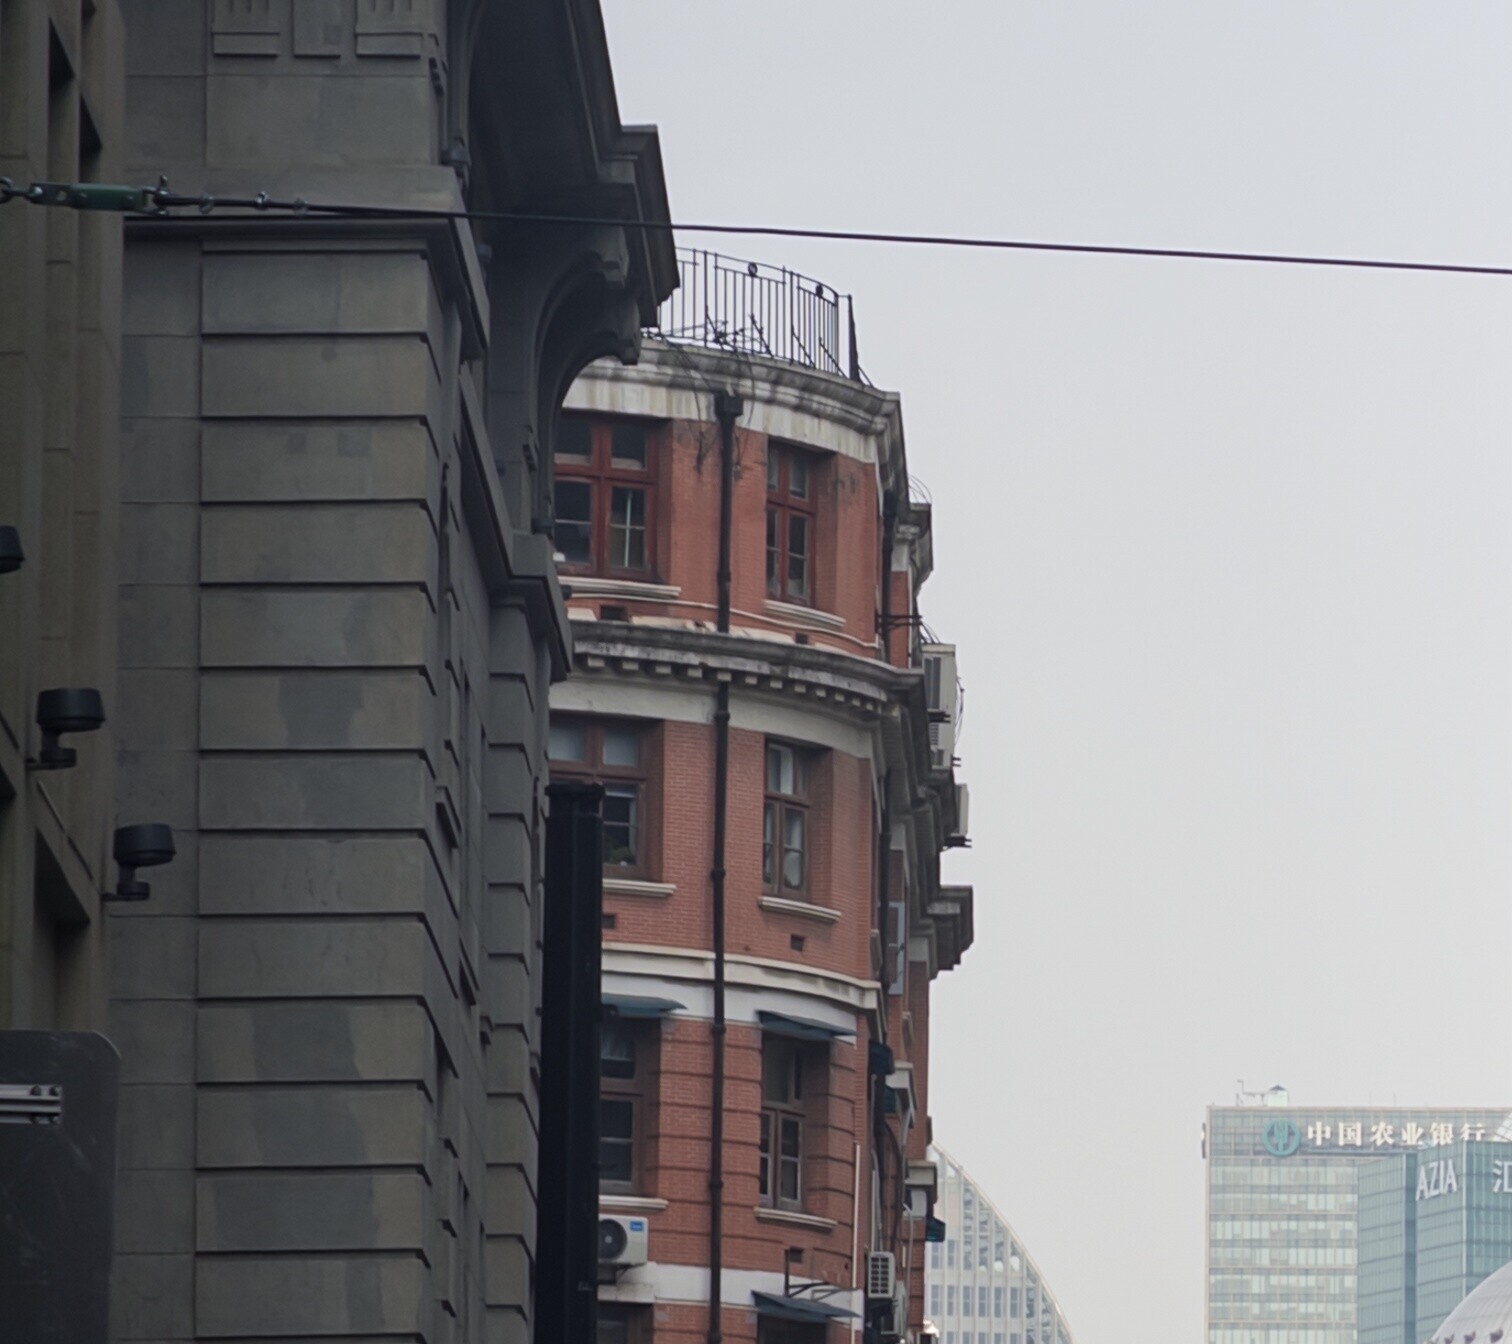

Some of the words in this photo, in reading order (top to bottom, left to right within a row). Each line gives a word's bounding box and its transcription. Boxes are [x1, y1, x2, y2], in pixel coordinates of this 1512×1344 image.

[1307, 1121, 1486, 1147] 中国农业银行
[1416, 1158, 1458, 1202] AZIA
